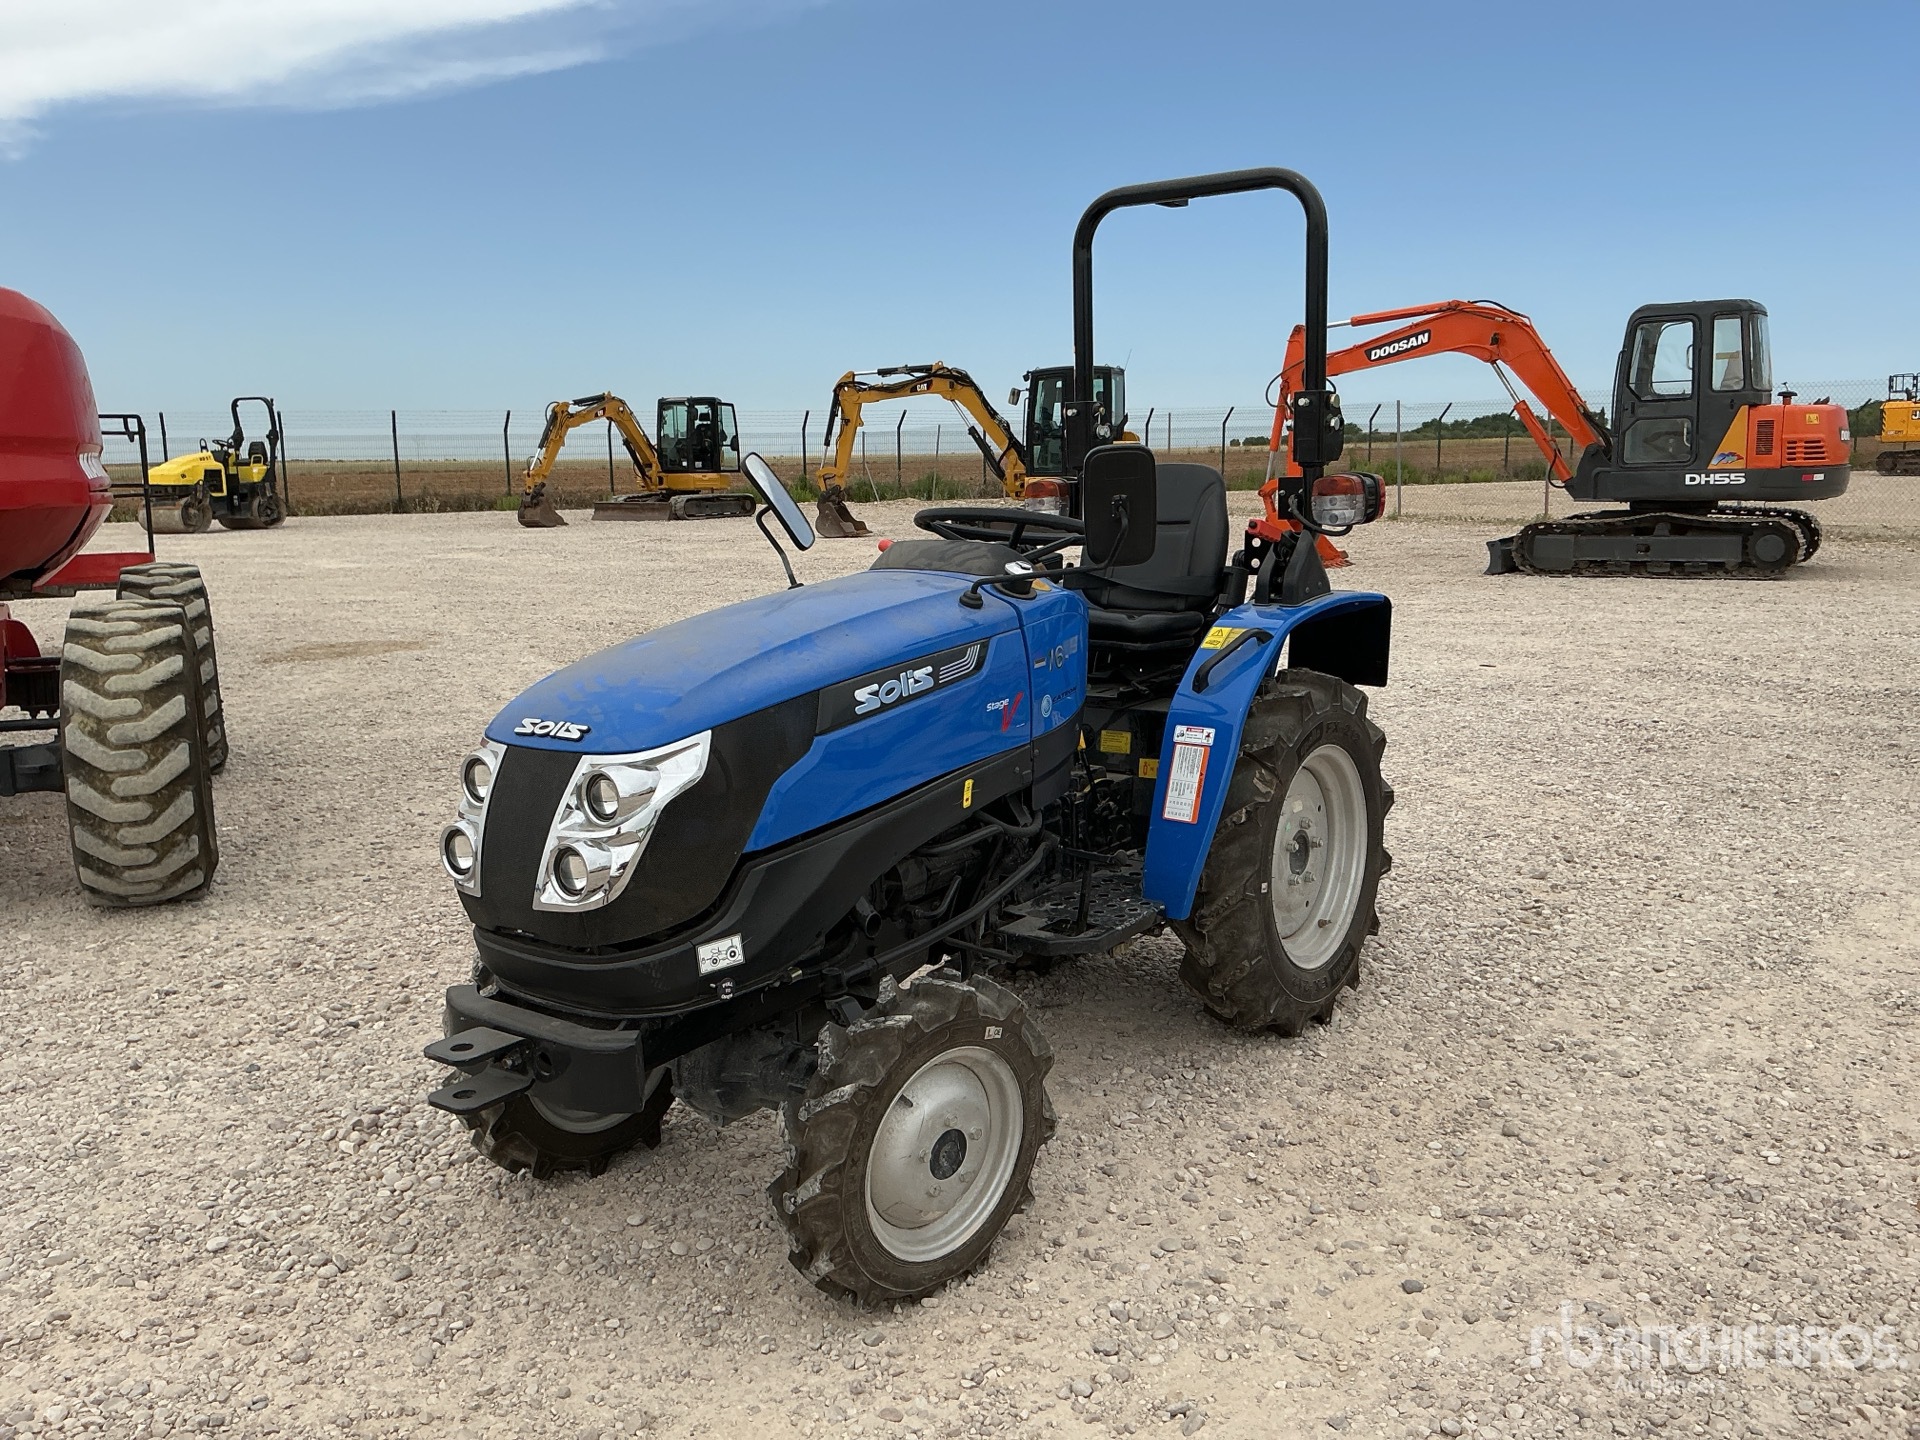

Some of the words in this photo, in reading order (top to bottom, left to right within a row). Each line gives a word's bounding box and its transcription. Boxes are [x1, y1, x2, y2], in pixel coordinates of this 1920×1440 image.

[1370, 332, 1429, 360] DOOSAN
[916, 382, 928, 392] CAT
[1685, 473, 1746, 485] DH55
[1002, 691, 1024, 733] V
